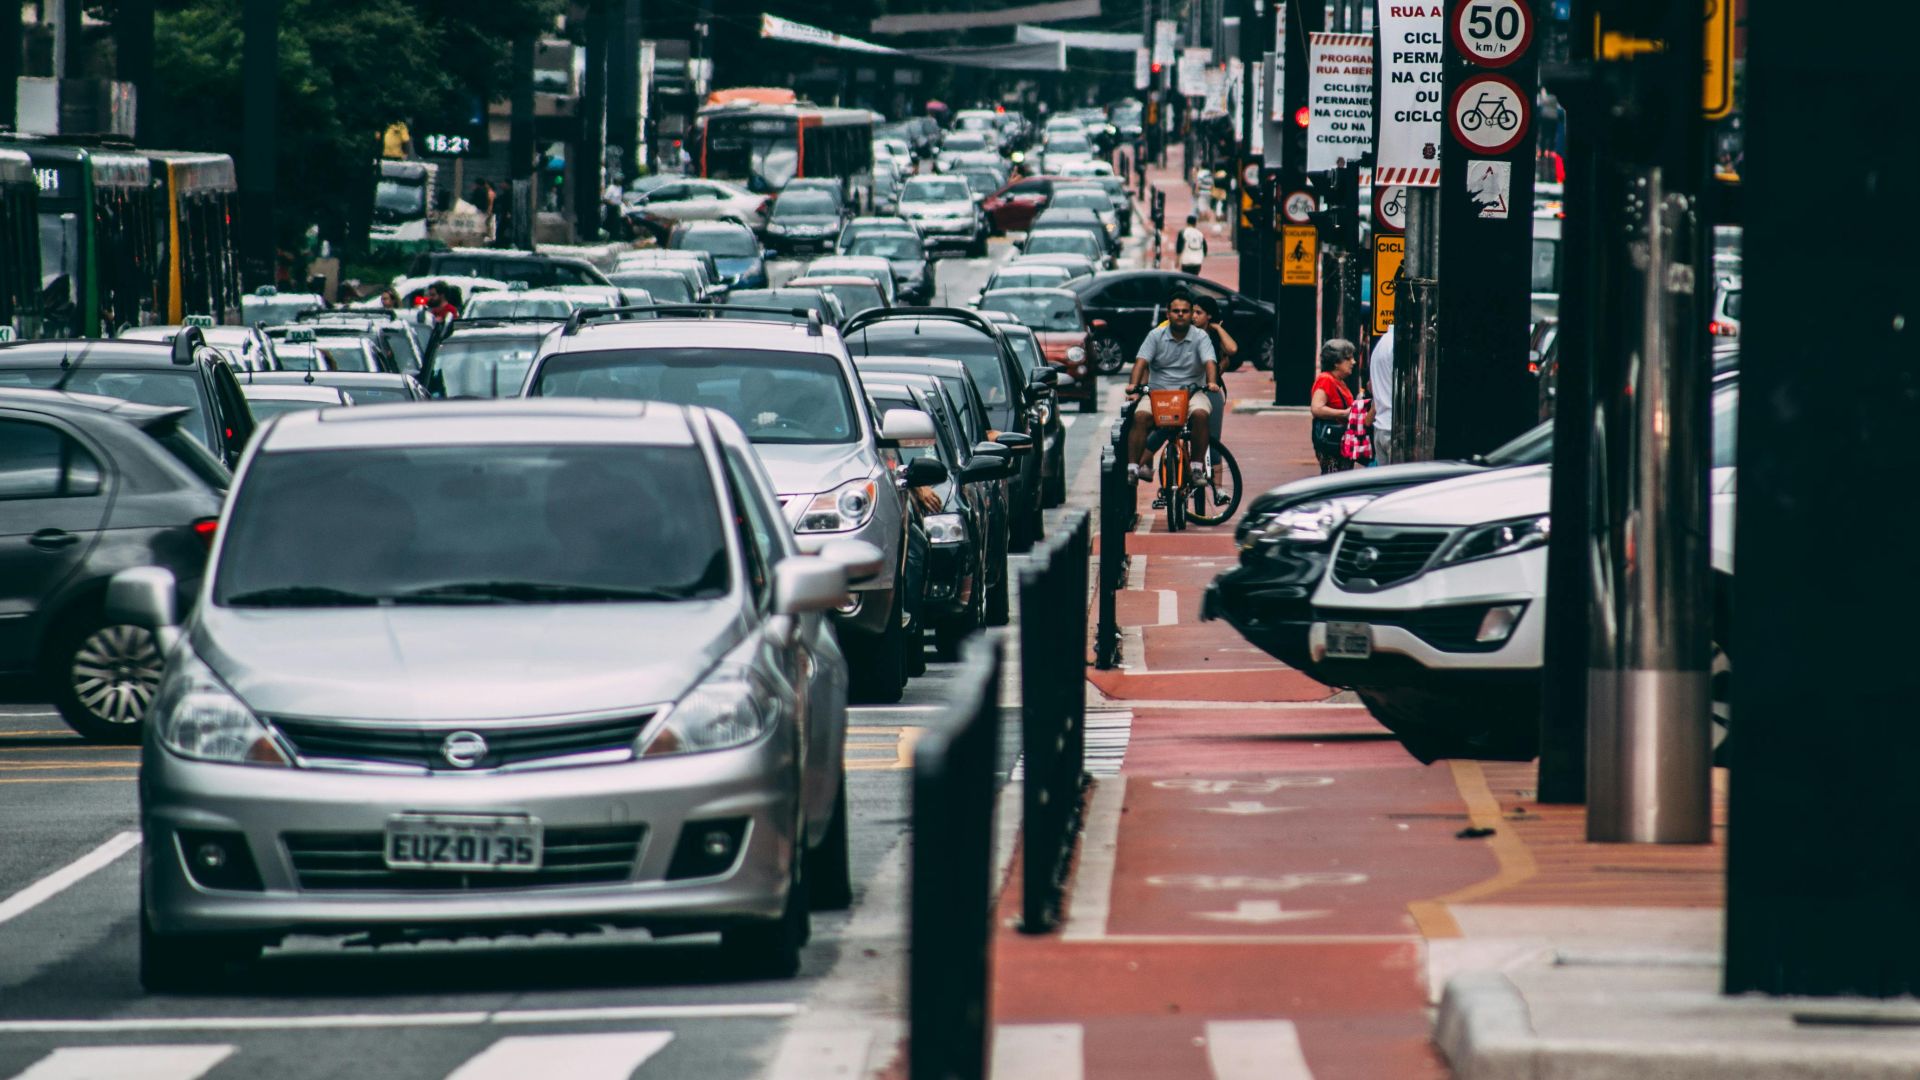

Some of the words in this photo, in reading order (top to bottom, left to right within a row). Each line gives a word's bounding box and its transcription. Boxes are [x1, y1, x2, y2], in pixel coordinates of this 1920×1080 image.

[1391, 6, 1425, 17] RUA
[1469, 5, 1519, 40] 50
[1404, 32, 1442, 44] CICL
[1476, 42, 1506, 52] km/h
[1316, 65, 1339, 74] RUA
[1392, 71, 1415, 83] NA
[1415, 91, 1439, 102] OU
[1314, 109, 1331, 117] NA
[1331, 122, 1347, 131] OU
[1351, 122, 1365, 131] NA
[187, 317, 211, 327] TAXI
[291, 330, 312, 340] TAXI
